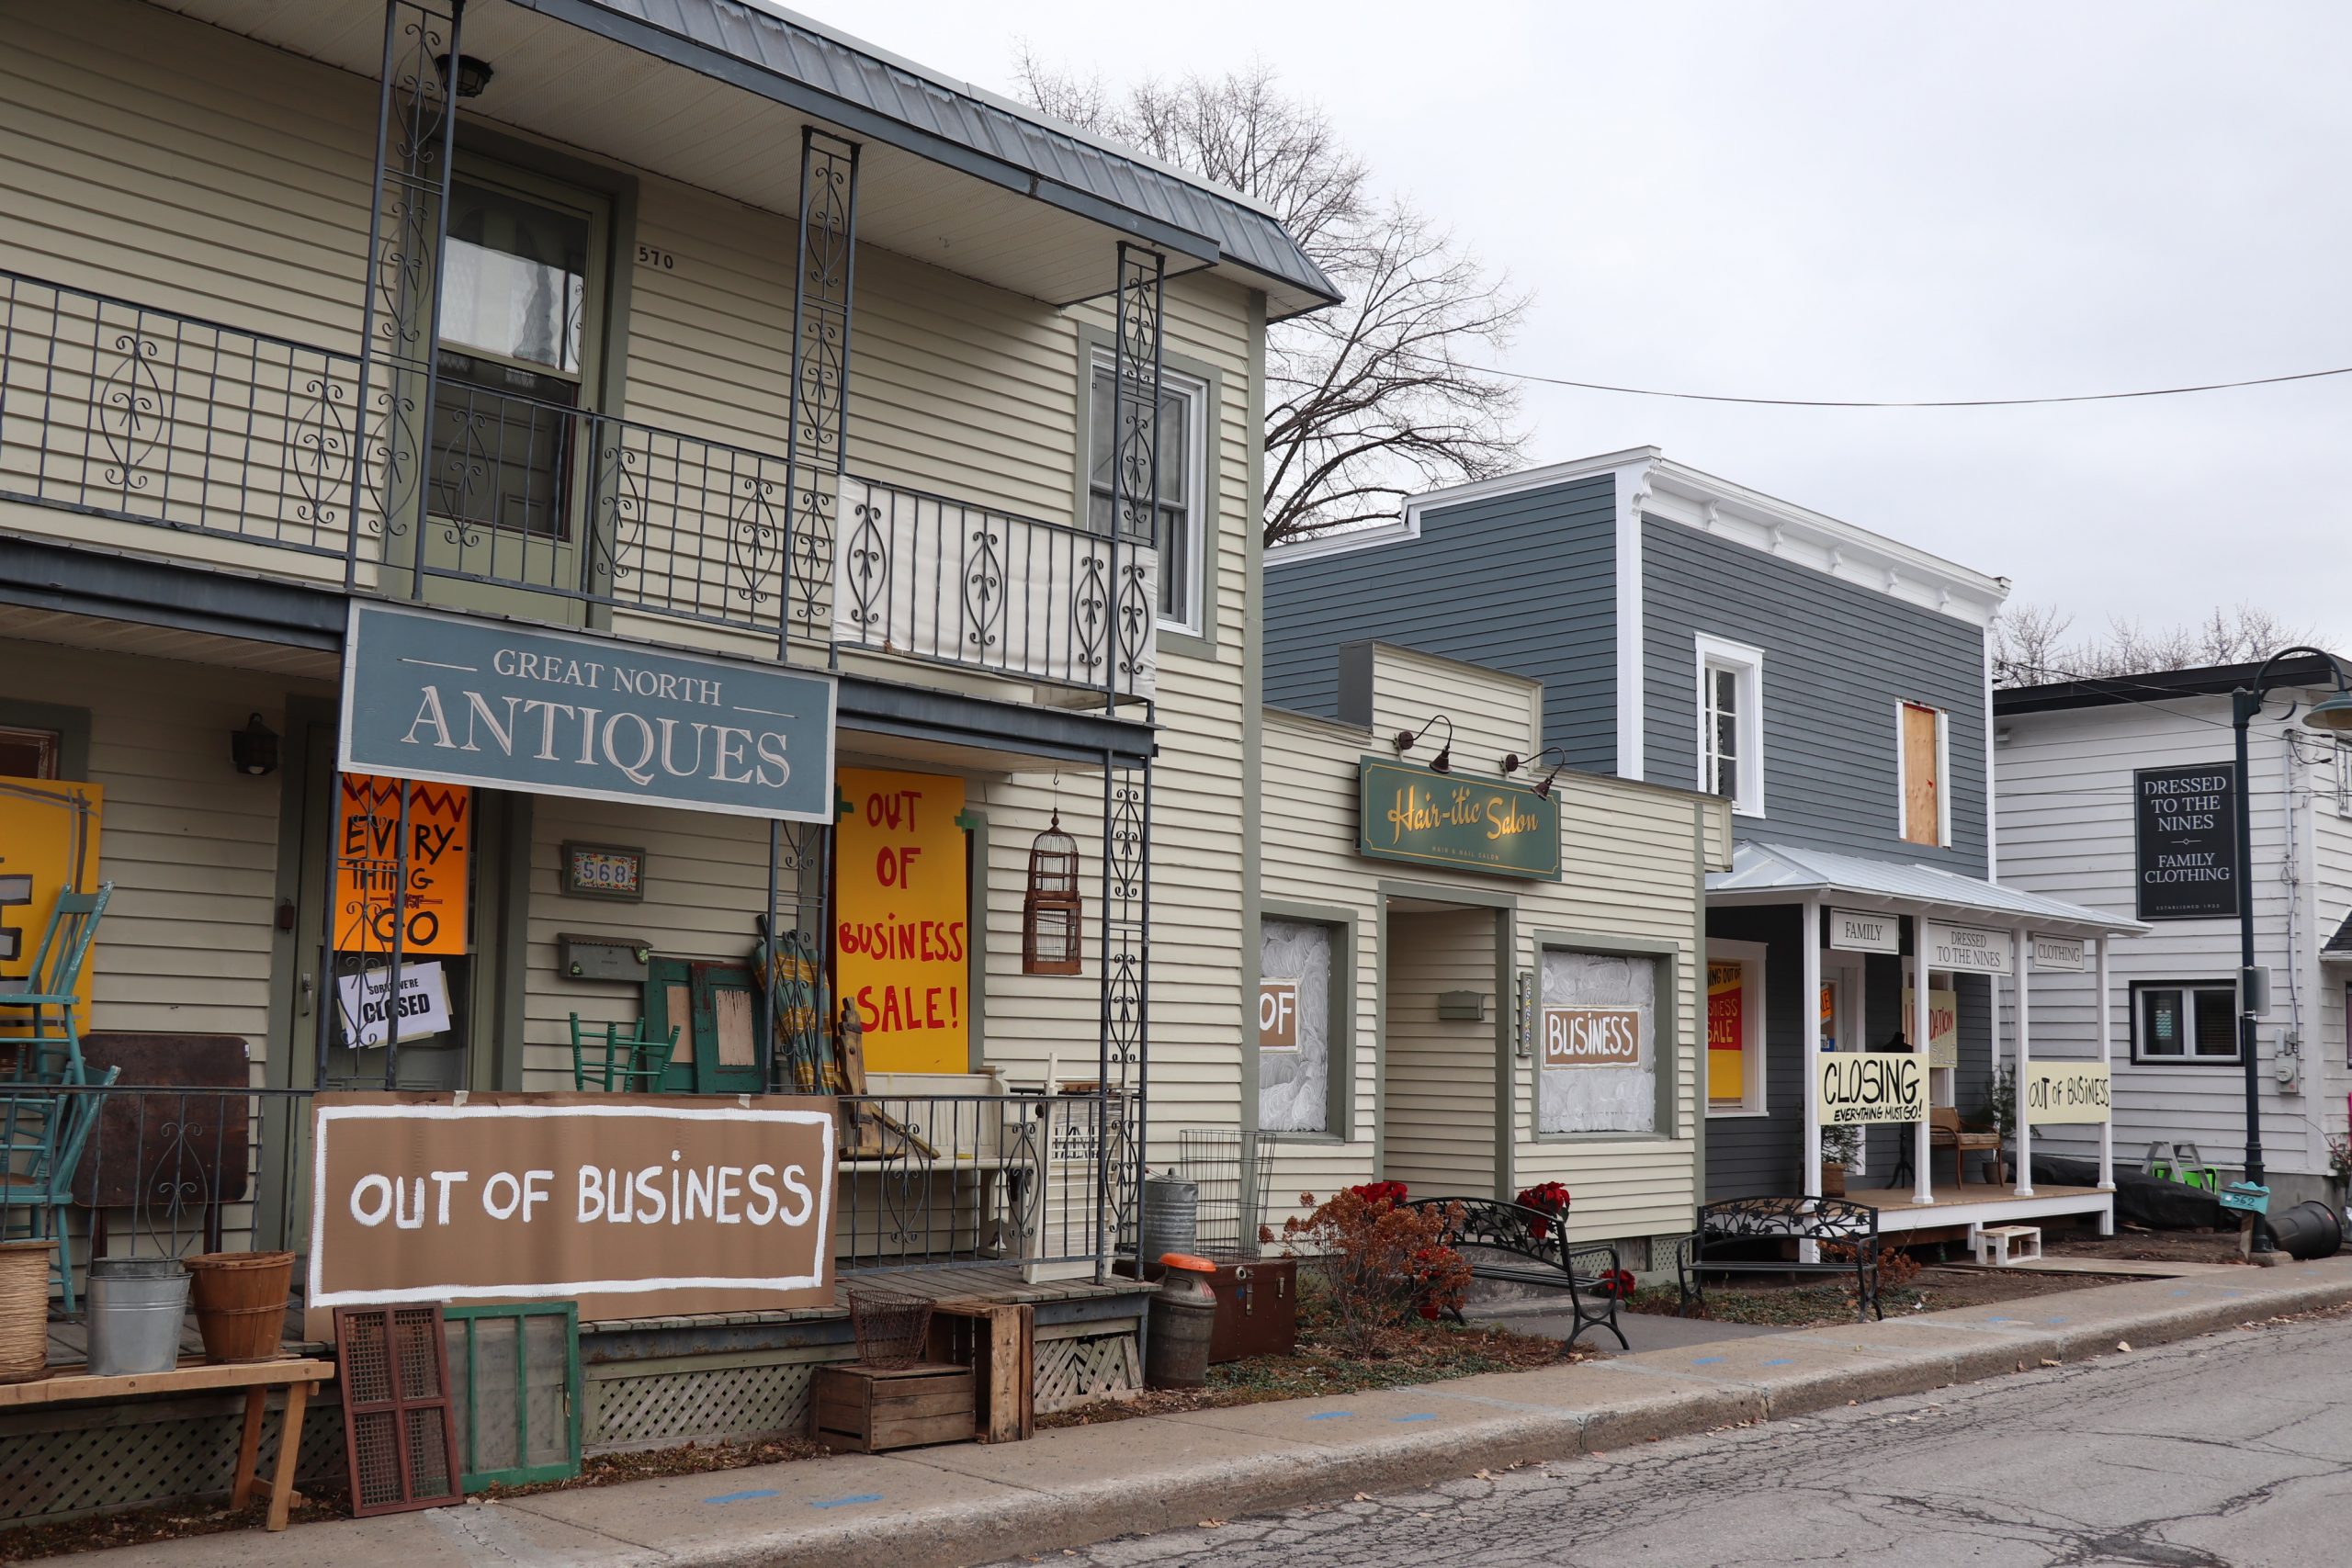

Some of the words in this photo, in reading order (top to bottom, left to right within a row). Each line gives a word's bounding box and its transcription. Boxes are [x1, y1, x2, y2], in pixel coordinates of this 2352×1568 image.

[639, 246, 673, 269] 570
[493, 649, 604, 689] GREAT
[613, 666, 722, 706] NORTH
[400, 684, 791, 787] ANTIQUES
[2144, 776, 2226, 795] DRESSED
[866, 790, 922, 832] OUT
[1387, 785, 1481, 845] Hair-itic
[1487, 795, 1538, 840] Salon
[2151, 798, 2177, 814] TO
[2182, 795, 2221, 811] THE
[2157, 815, 2214, 831] NINES
[876, 845, 922, 890] OF
[1478, 852, 1499, 861] SALON
[2158, 852, 2215, 868] FAMILY
[583, 862, 626, 883] 568
[2144, 867, 2230, 884] CLOTHING
[372, 908, 438, 946] GO
[1845, 921, 1883, 942] FAMILY
[1951, 931, 1986, 947] DRESSED
[1937, 945, 1951, 963] TO
[1953, 949, 1972, 964] THE
[1974, 950, 2000, 967] NINES
[2038, 943, 2080, 963] CLOTHING
[856, 985, 958, 1032] SALE!
[1260, 992, 1295, 1035] OF
[1824, 1059, 1920, 1105] CLOSING
[2029, 1077, 2051, 1110] OUT
[2052, 1080, 2063, 1106] OF
[1834, 1106, 1883, 1122] EVERYTHING
[1884, 1106, 1903, 1120] MUST
[1903, 1099, 1923, 1120] GO!
[351, 1170, 468, 1228] OUT
[482, 1170, 554, 1223] OF
[2233, 1194, 2255, 1207] 562
